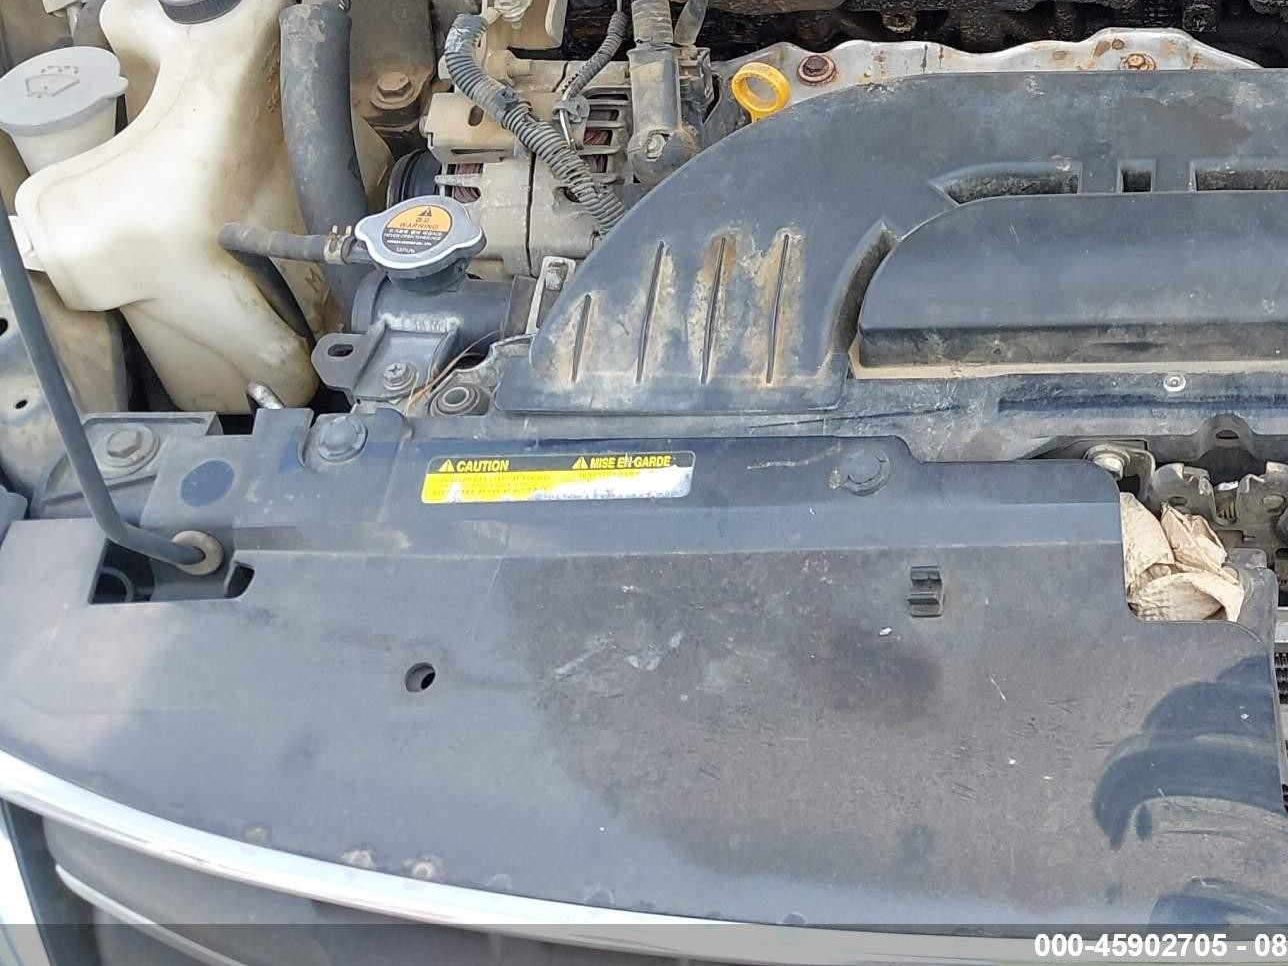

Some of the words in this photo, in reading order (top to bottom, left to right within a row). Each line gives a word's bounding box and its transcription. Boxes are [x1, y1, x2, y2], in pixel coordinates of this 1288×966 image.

[399, 222, 439, 230] WARNING
[456, 460, 509, 472] CAUTION
[589, 458, 615, 469] MISE
[633, 456, 671, 468] GARDE
